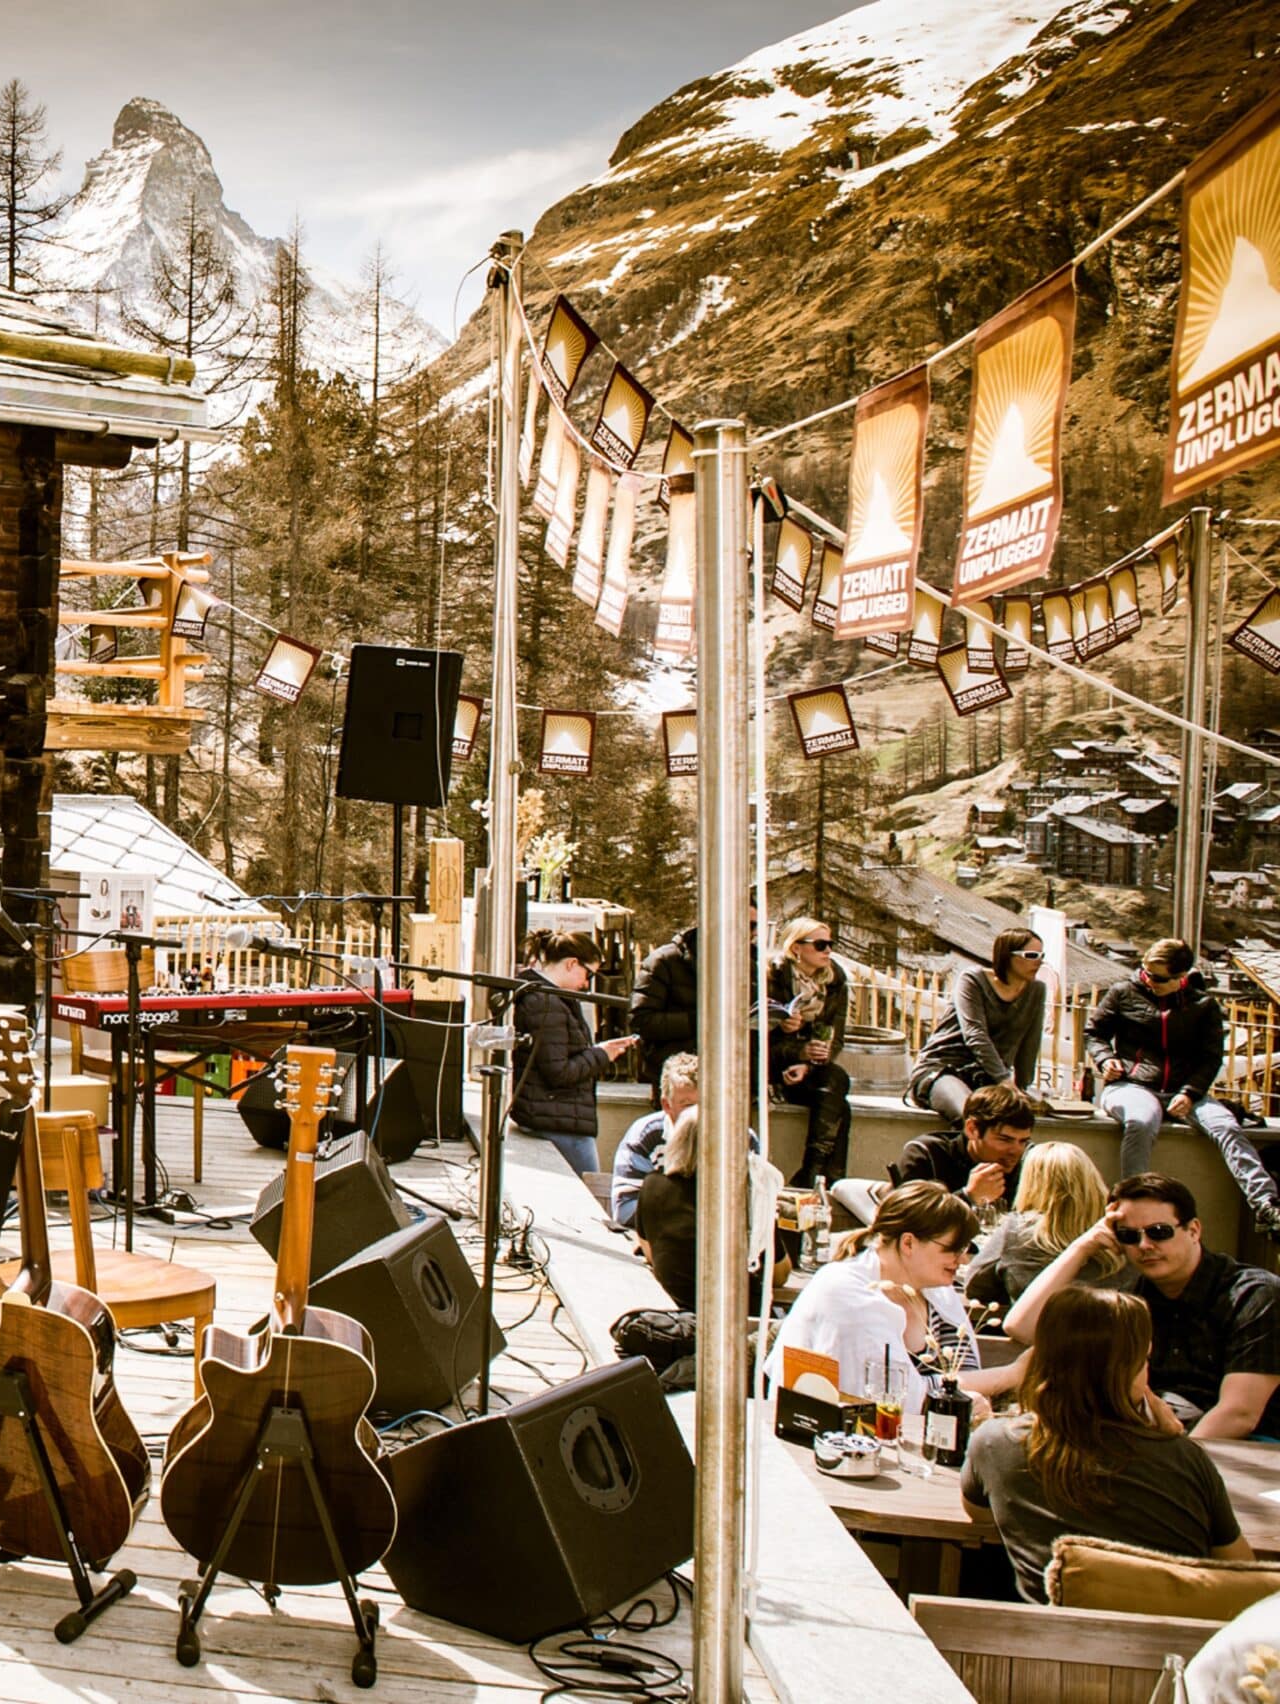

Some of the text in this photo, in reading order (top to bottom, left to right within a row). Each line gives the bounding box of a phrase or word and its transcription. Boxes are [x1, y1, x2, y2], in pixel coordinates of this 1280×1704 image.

[962, 497, 1054, 560] ZERMATT
[959, 532, 1047, 585] UNPLUGGED
[842, 561, 910, 600] ZERMATT
[840, 592, 908, 623] UNPLUGGED
[955, 680, 1002, 704] ZERMATT
[805, 730, 852, 746] ZERMATT
[541, 755, 589, 766] ZERMATT
[541, 762, 589, 772] UNPLUGGED
